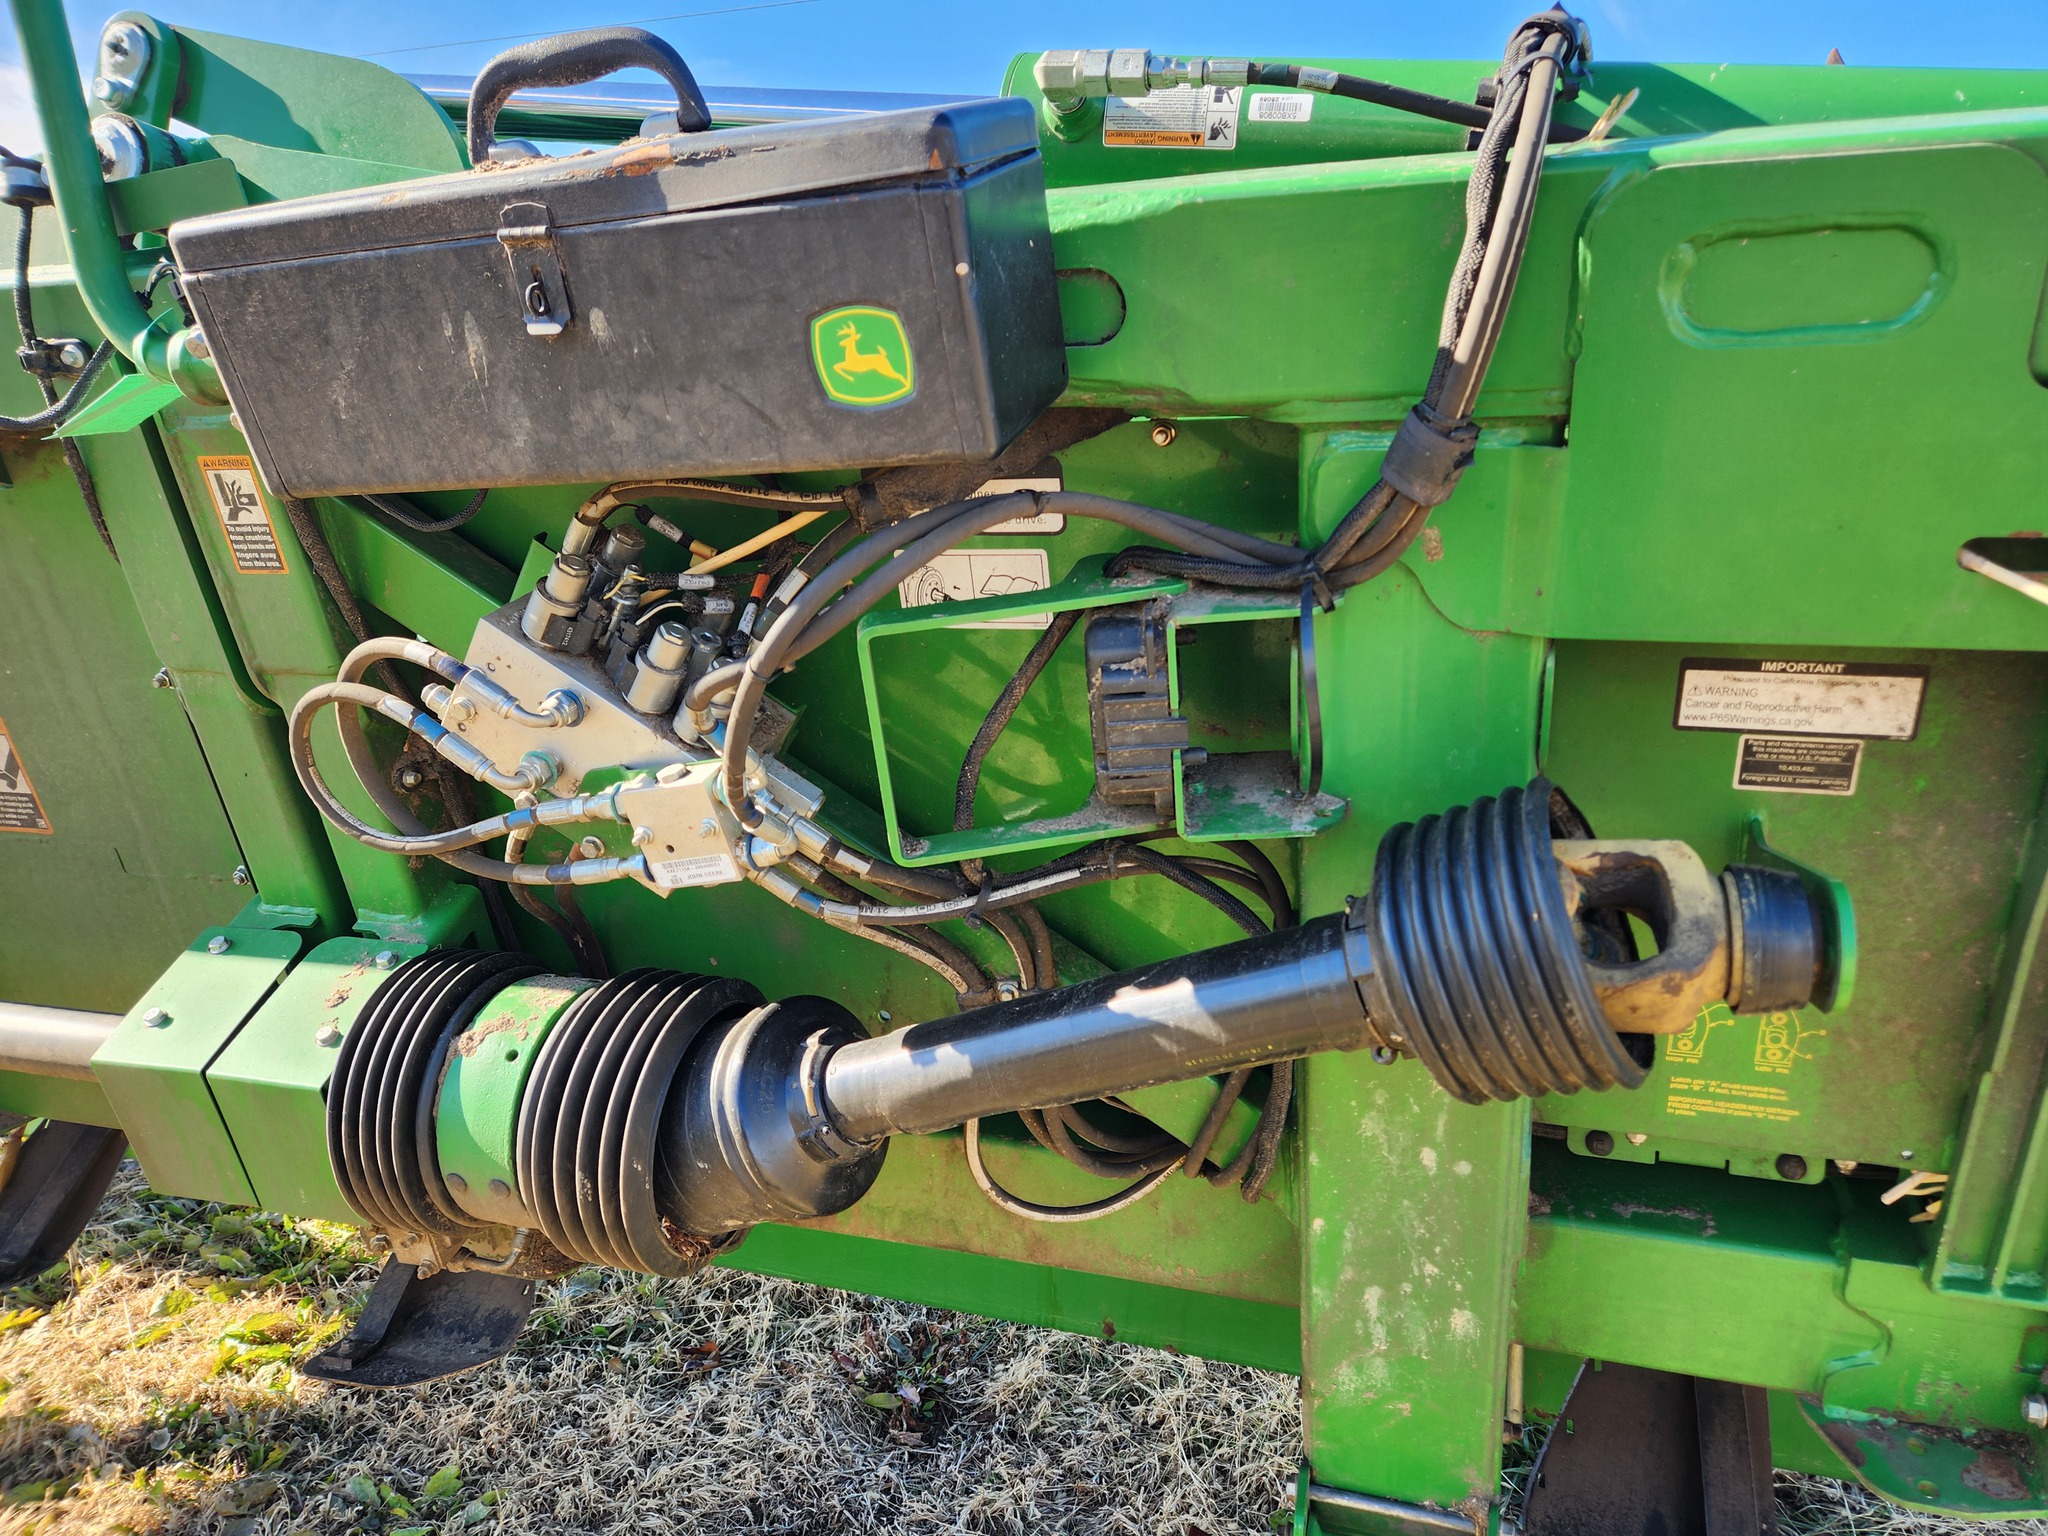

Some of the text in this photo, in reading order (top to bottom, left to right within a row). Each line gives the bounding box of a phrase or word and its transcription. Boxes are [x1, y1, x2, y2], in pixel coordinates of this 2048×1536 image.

[1157, 134, 1190, 143] WARNING
[209, 458, 250, 467] WARNING
[1761, 661, 1846, 674] IMPORTANT
[1723, 675, 1760, 684] Pursuant
[1773, 677, 1814, 686] California
[1816, 679, 1866, 688] Proposition
[1705, 686, 1759, 698] WARNING
[1685, 698, 1843, 714] Cancer and Reproductive Harm
[1684, 712, 1814, 728] www.P65Warnings.ca.gov
[1781, 741, 1825, 749] mechanisms
[1741, 774, 1766, 782] Foreign
[1820, 778, 1848, 787] pending
